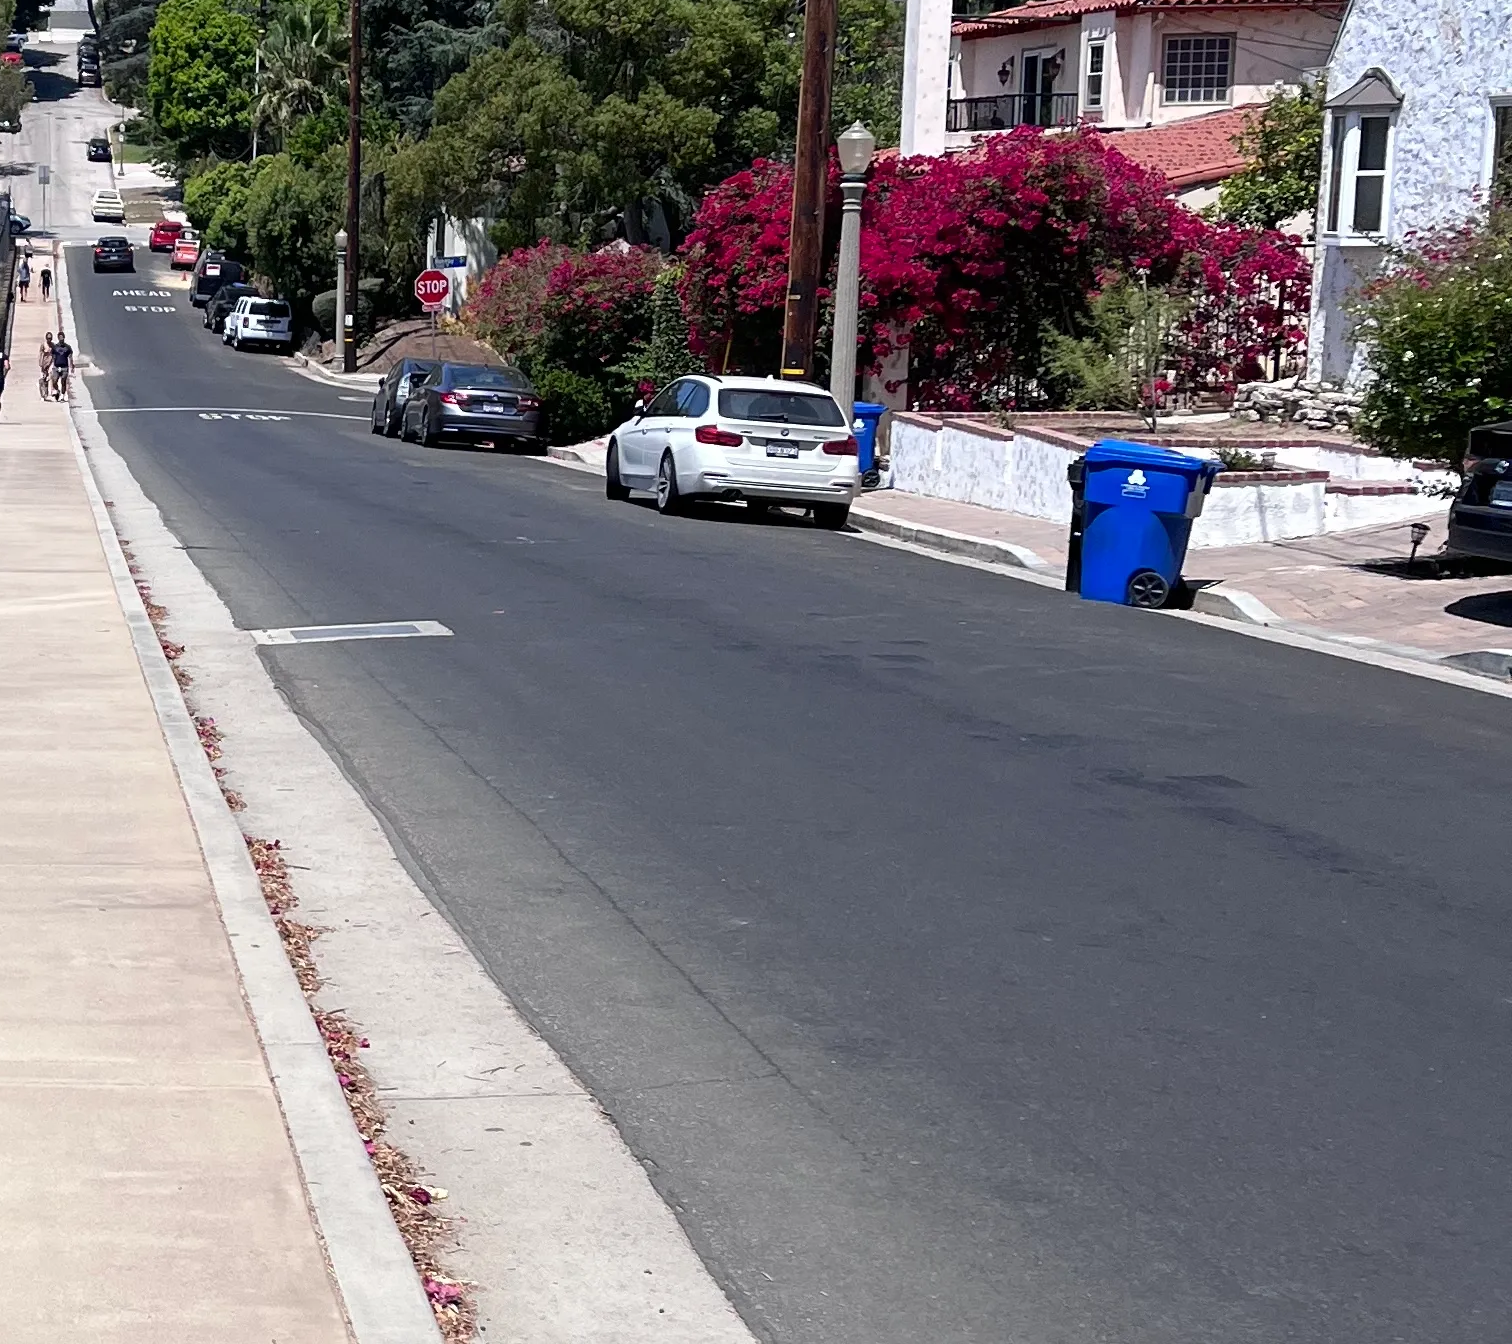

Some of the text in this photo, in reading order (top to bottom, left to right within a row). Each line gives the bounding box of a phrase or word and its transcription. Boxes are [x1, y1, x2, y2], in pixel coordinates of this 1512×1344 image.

[417, 280, 447, 295] STOP
[124, 305, 176, 313] STOP
[198, 413, 292, 421] STOP
